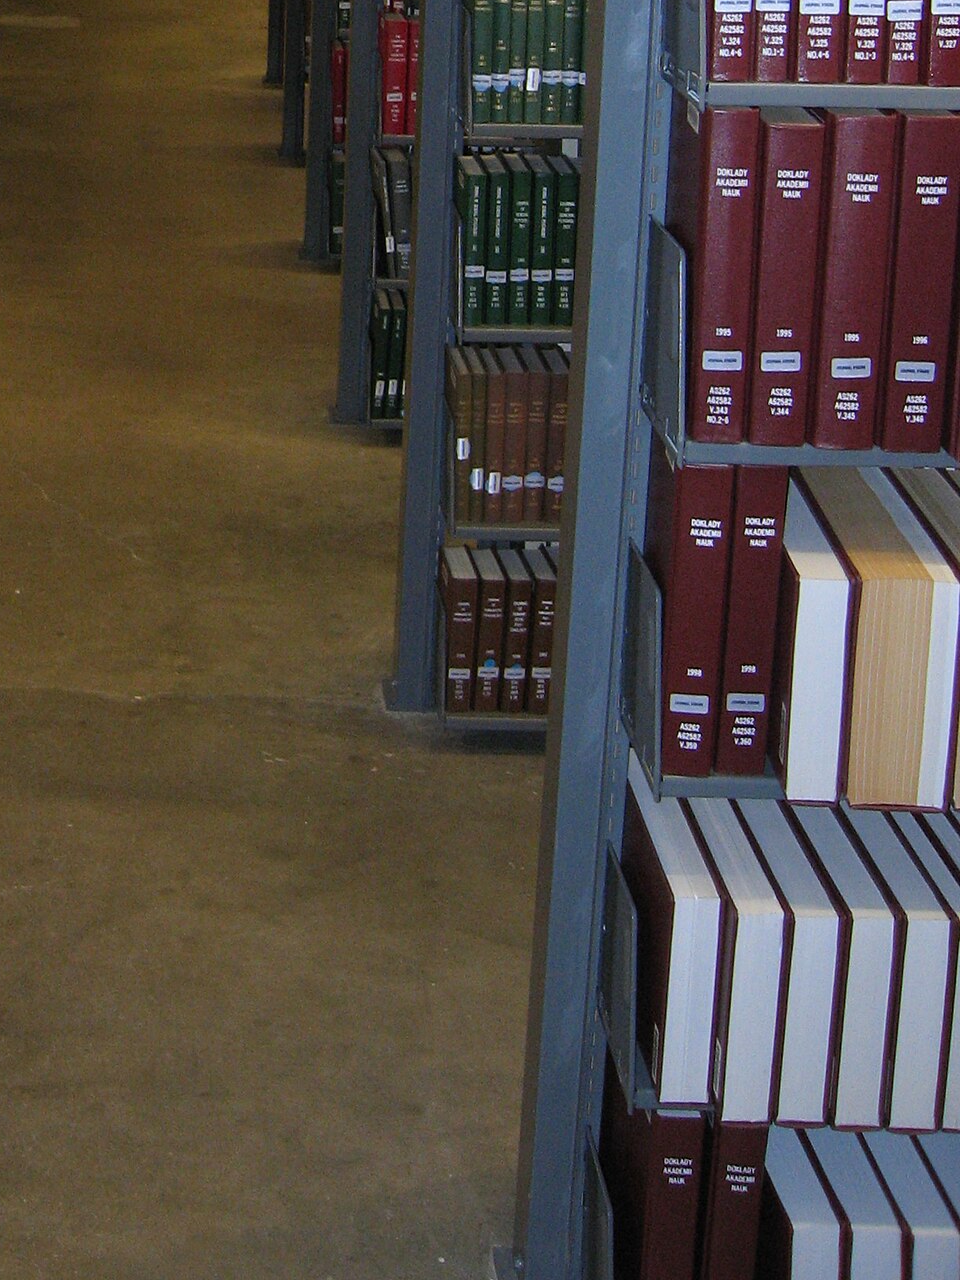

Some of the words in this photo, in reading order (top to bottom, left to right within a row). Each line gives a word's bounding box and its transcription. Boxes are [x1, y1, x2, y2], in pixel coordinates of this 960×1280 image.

[722, 14, 743, 22] AS262
[810, 16, 830, 24] AS262
[857, 17, 877, 25] AS262
[939, 17, 958, 25] AS262
[722, 37, 740, 45] V.324
[717, 169, 747, 177] DOKLADY
[777, 170, 808, 179] DOKLADY
[716, 178, 748, 187] AKADEMII
[847, 173, 878, 183] DOKLADY
[917, 176, 947, 185] DOKLADY
[777, 180, 809, 188] AKADEMII
[846, 184, 878, 192] AKADEMII
[722, 188, 740, 197] NAUK
[783, 190, 801, 199] NAUK
[916, 186, 947, 195] AKADEMII
[852, 194, 870, 202] NAUK
[921, 196, 939, 205] NAUK
[777, 329, 792, 337] 1995
[844, 333, 859, 342] 1995
[710, 387, 730, 395] AS262
[771, 388, 791, 396] AS262
[837, 393, 858, 401] AS262
[906, 395, 926, 404] AS262
[771, 408, 789, 416] V.344
[691, 519, 721, 528] DOKLADY
[745, 517, 775, 526] DOKLADY
[690, 528, 721, 538] AKADEMII
[744, 527, 775, 537] AKADEMII
[696, 538, 714, 547] NAUK
[749, 538, 767, 547] NAUK
[735, 717, 754, 726] AS262
[680, 723, 700, 731] AS262
[664, 1158, 692, 1167] DOKLADY
[727, 1166, 756, 1174] DOKLADY
